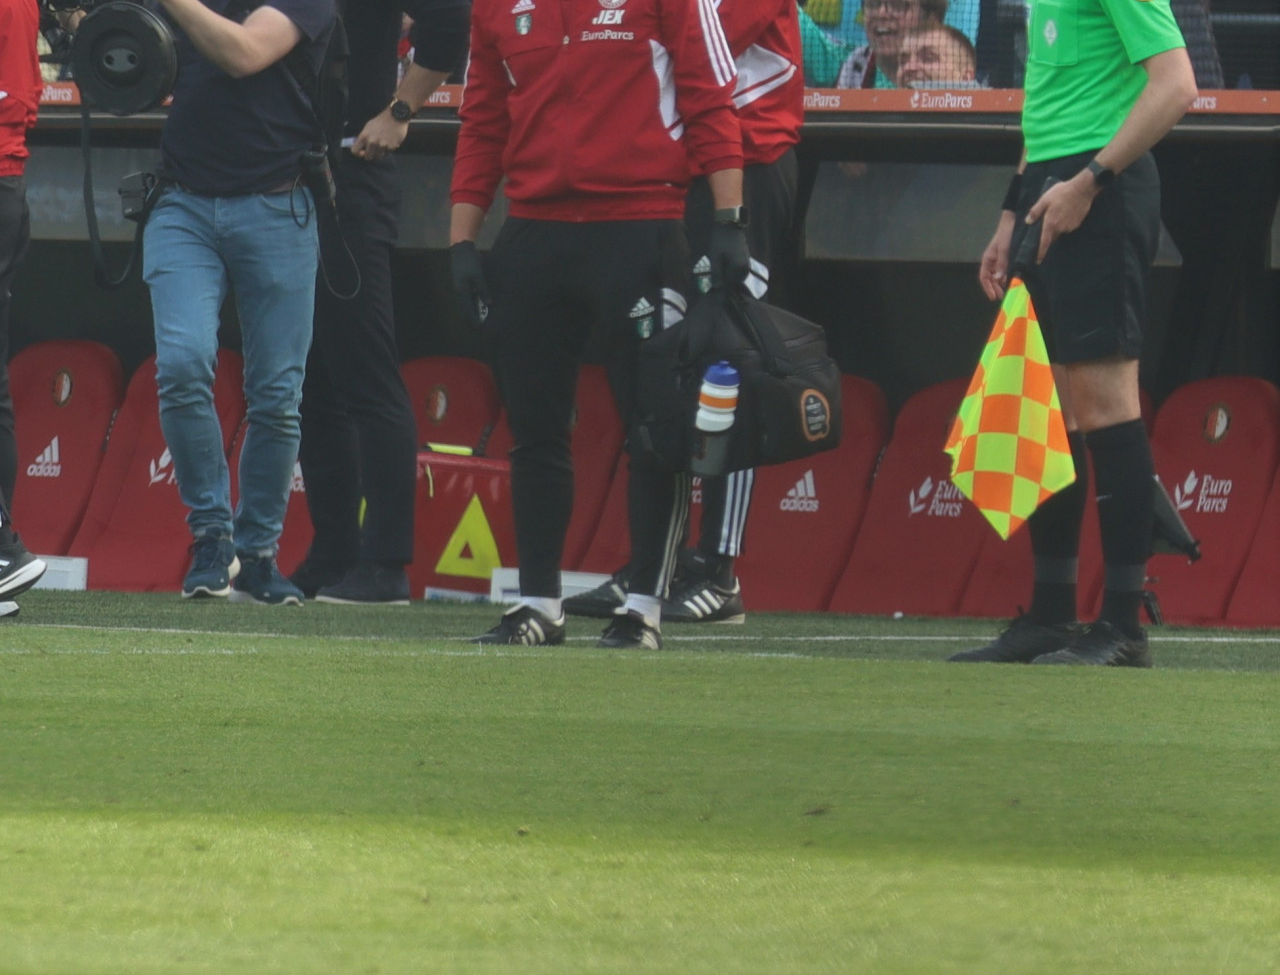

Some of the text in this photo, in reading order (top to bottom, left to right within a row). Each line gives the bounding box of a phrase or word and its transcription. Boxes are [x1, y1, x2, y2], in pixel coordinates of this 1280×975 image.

[592, 10, 626, 25] JEX
[581, 29, 635, 41] EuroParcs
[920, 92, 973, 108] EuroParcs
[27, 462, 62, 478] adidas
[1201, 474, 1233, 496] Euro
[779, 497, 819, 513] adidas
[928, 499, 962, 517] Parcs
[1195, 495, 1228, 513] Parcs
